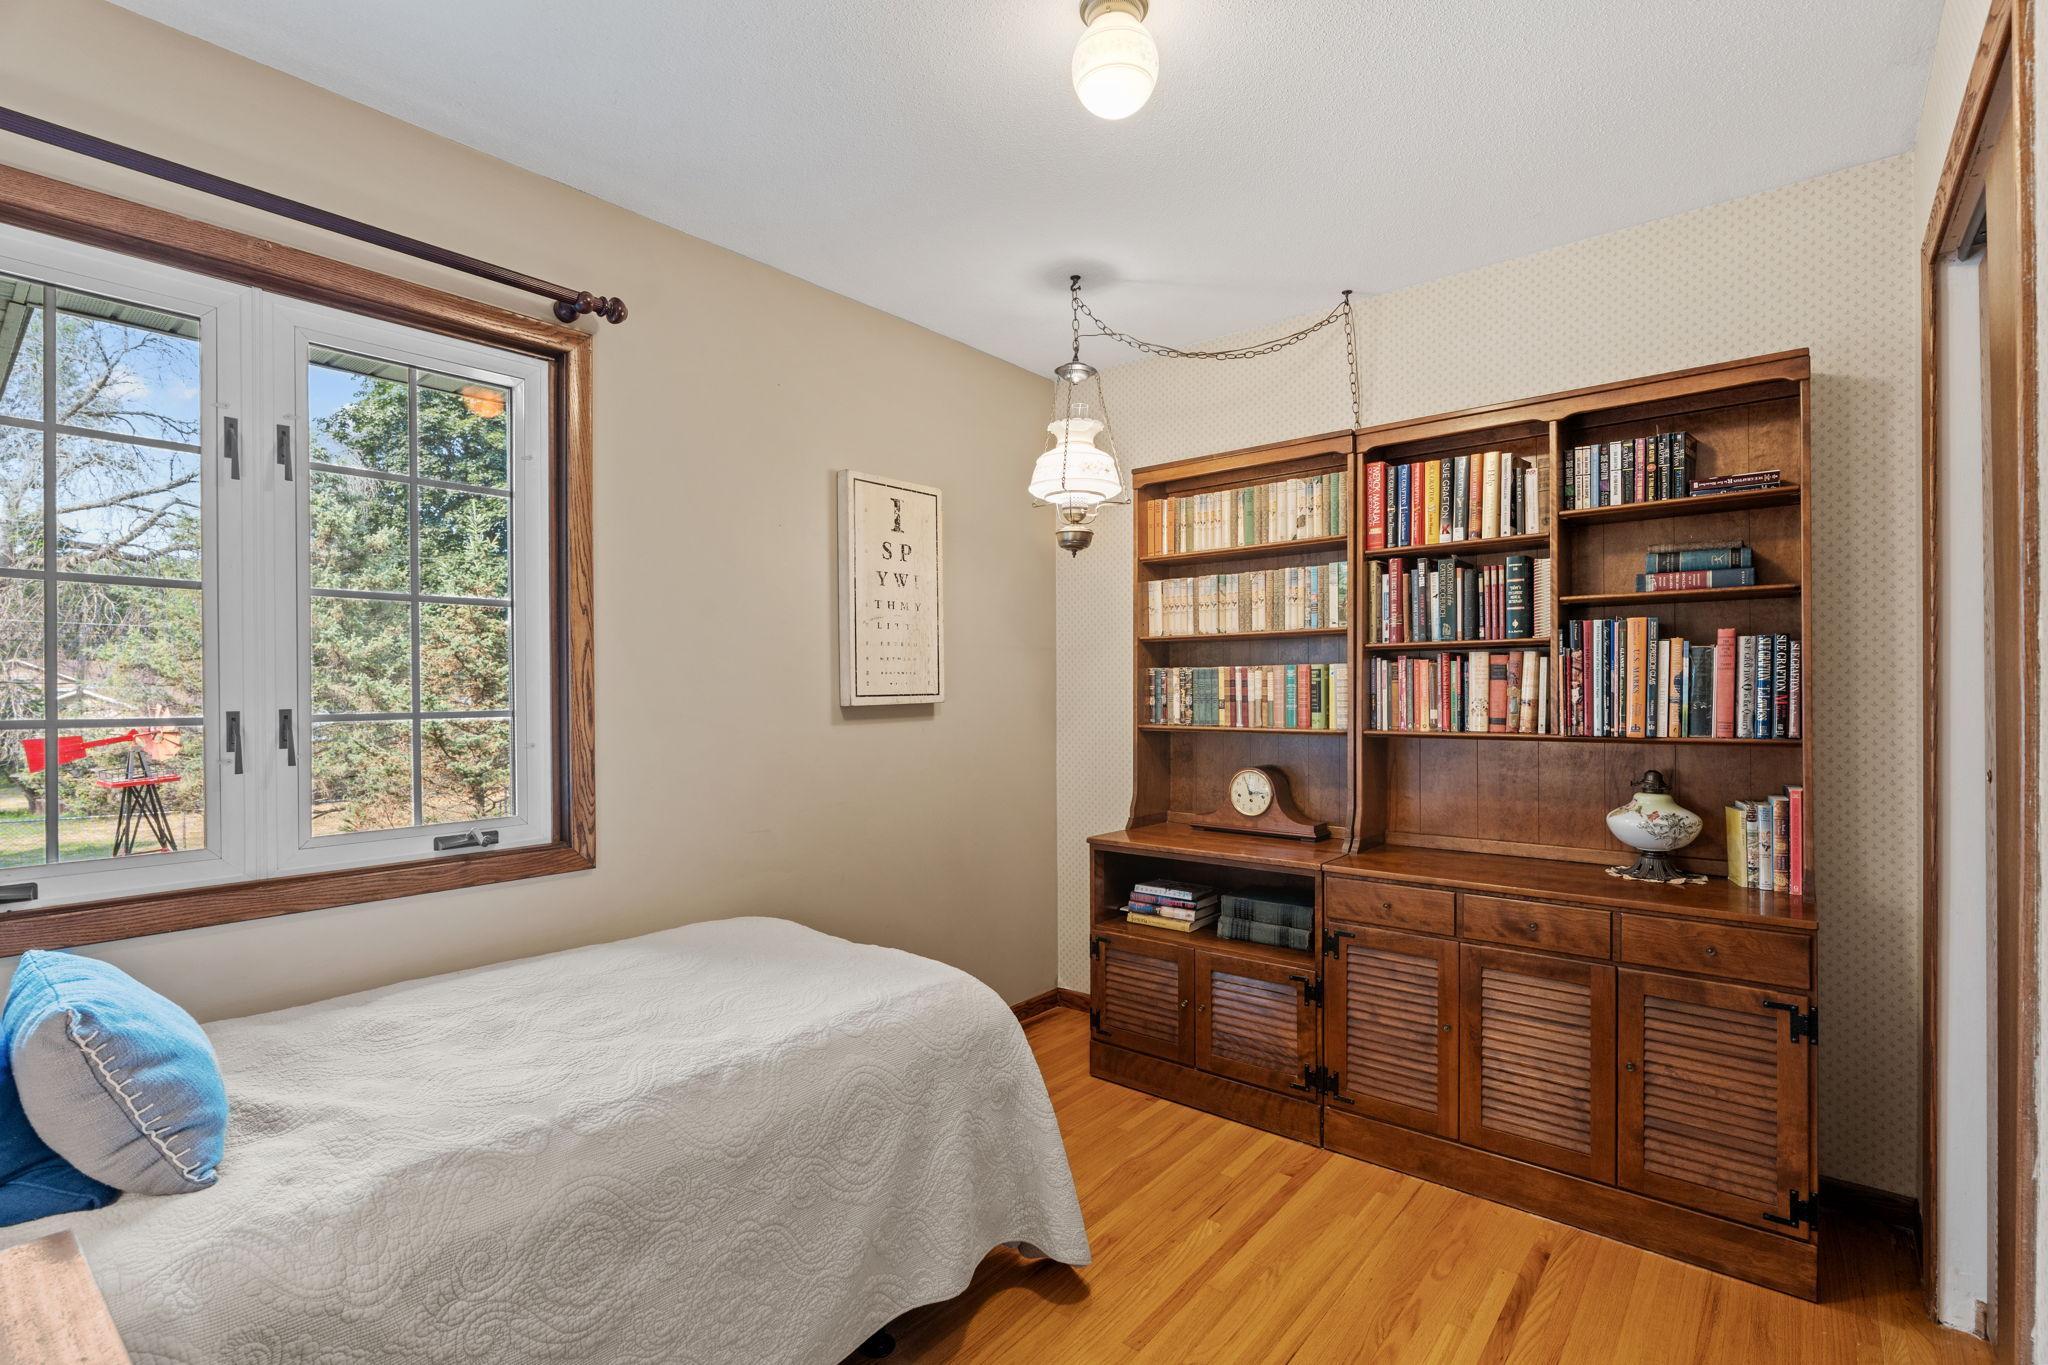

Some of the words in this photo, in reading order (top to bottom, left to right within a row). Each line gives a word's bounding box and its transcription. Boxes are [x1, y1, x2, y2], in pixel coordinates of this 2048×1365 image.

[1442, 463, 1450, 478] SUE
[1373, 494, 1381, 526] MANUAL
[1442, 480, 1450, 518] GRAFTON
[1442, 524, 1450, 534] X
[1758, 637, 1772, 650] SUE
[1776, 634, 1787, 650] SUE
[1790, 642, 1800, 657] SUE
[1744, 652, 1753, 682] GRAFTON
[1758, 650, 1772, 680] GRAFTON
[1776, 652, 1787, 692] GRAFTON
[1790, 658, 1800, 692] GRAFTON
[1776, 694, 1788, 704] M
